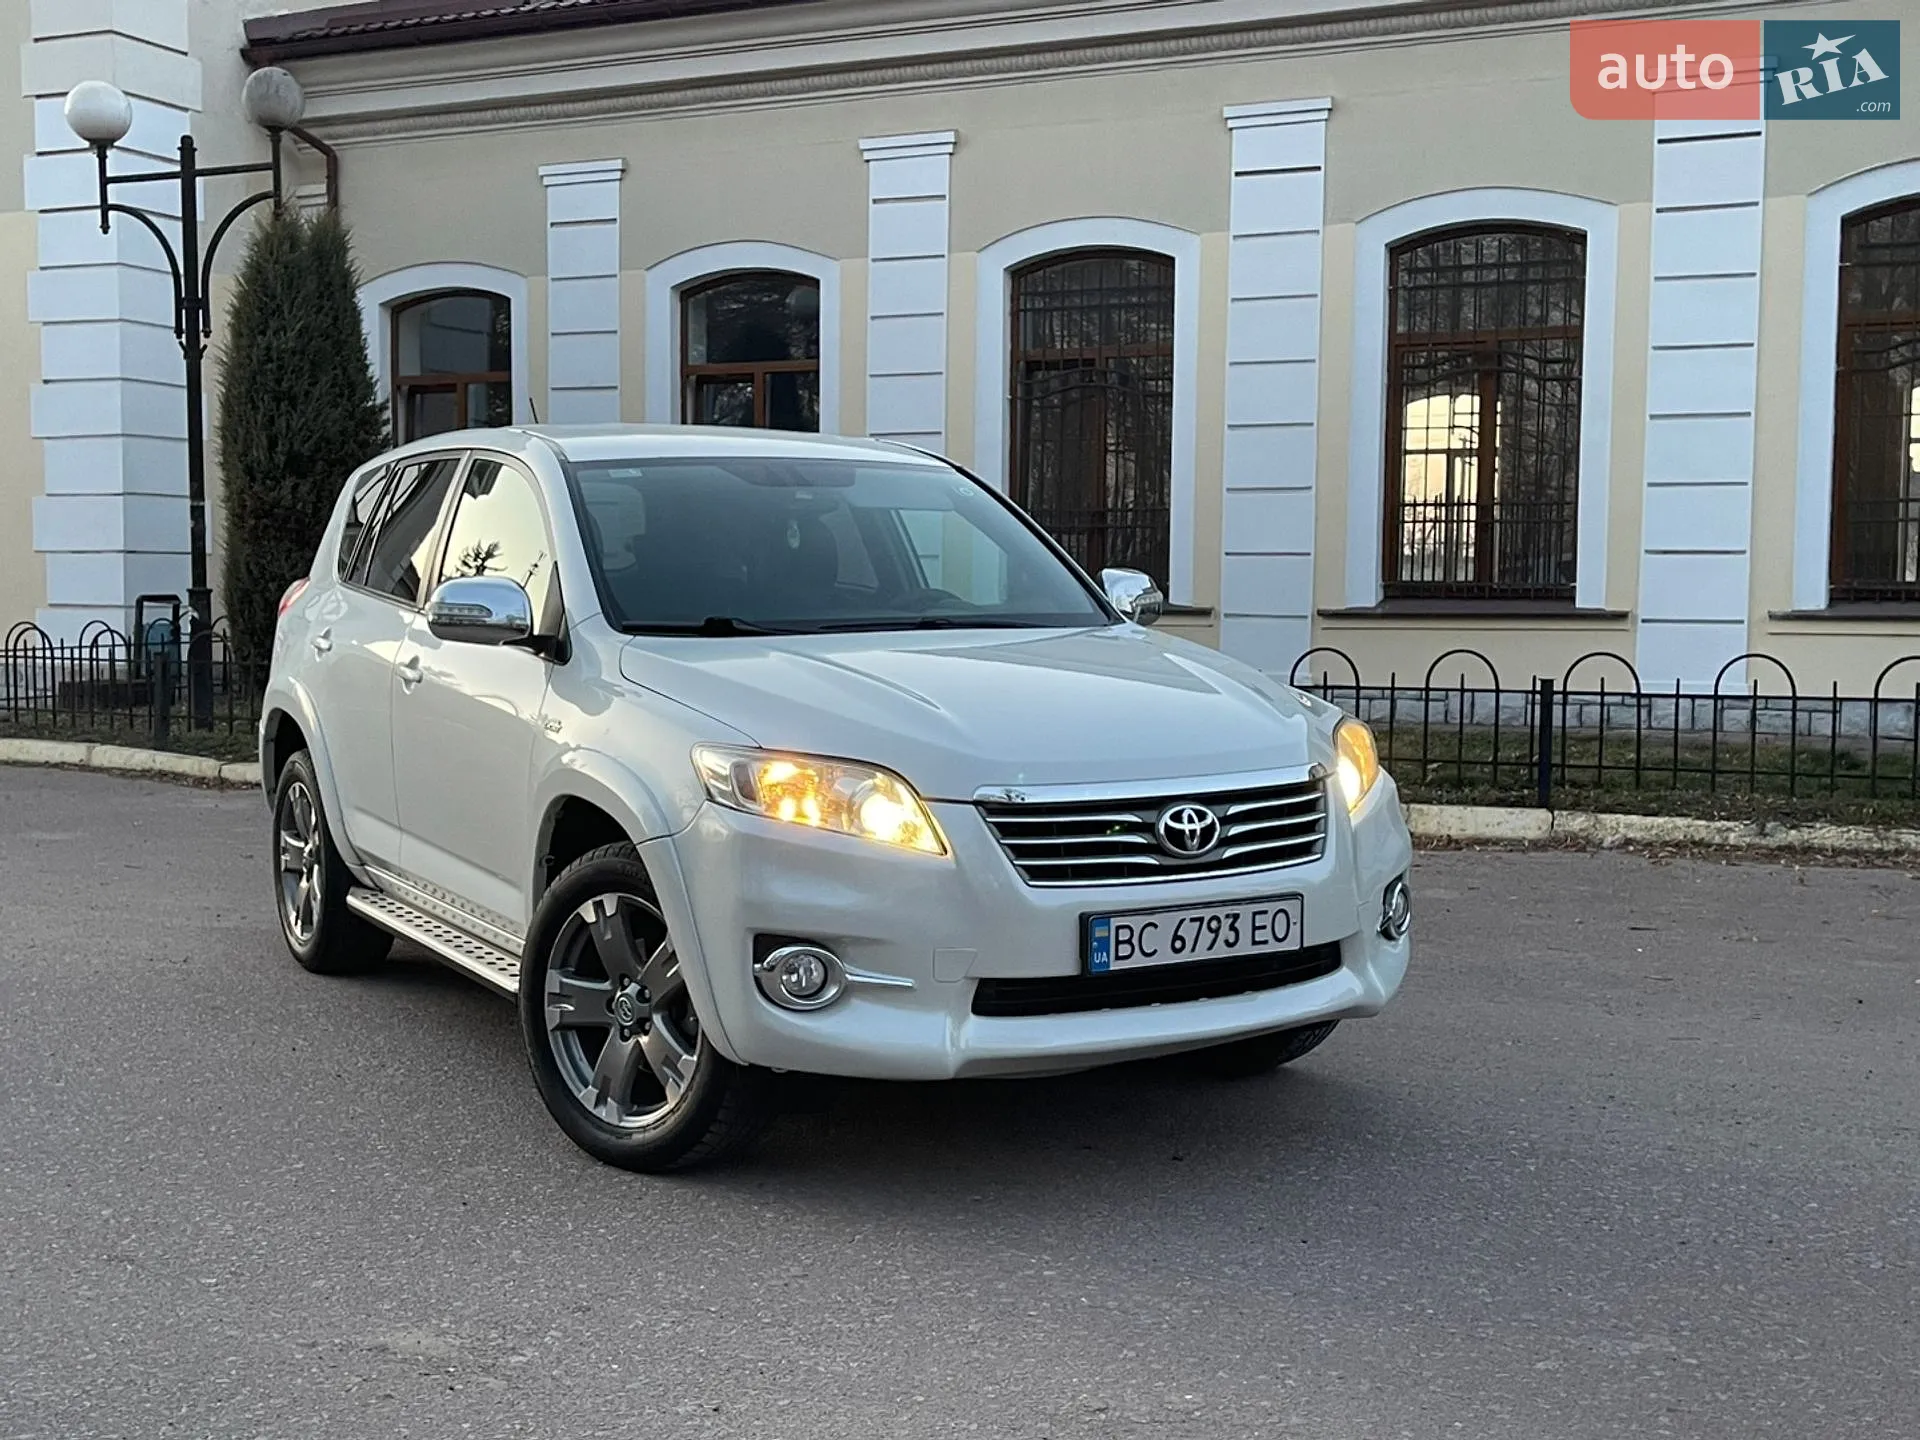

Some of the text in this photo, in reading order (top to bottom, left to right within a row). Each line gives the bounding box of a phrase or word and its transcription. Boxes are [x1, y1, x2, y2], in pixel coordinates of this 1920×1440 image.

[1114, 908, 1291, 961] BC 6793 EO
[1093, 952, 1108, 964] UA
